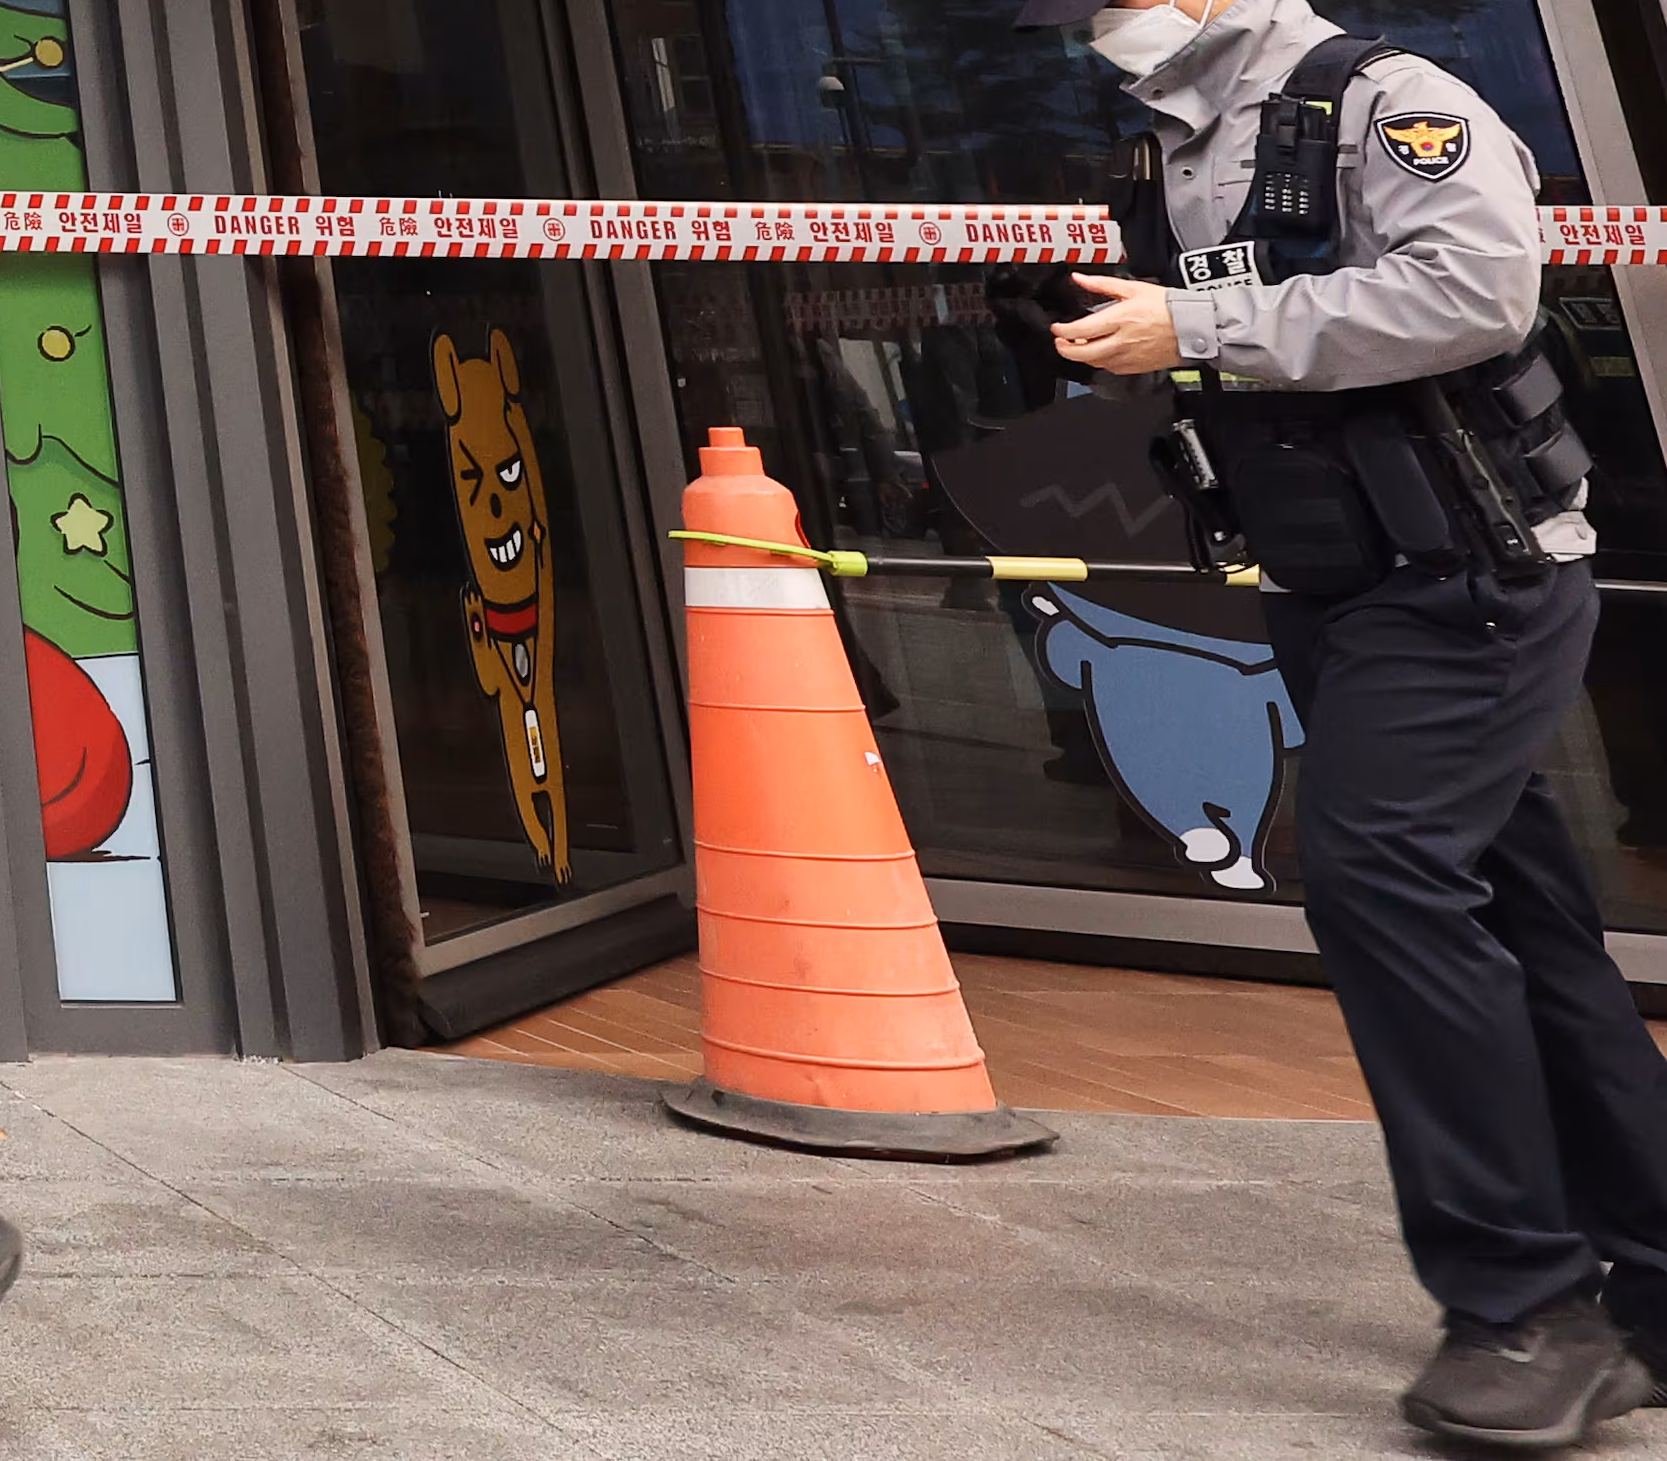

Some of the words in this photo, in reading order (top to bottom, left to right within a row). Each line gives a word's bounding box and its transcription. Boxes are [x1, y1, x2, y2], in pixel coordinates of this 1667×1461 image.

[58, 212, 143, 233] 안전제일
[214, 215, 301, 235] DANGER
[315, 216, 356, 237] 위험
[434, 217, 519, 239] 안전제일
[590, 220, 677, 240] DANGER
[690, 220, 732, 242] 위험
[809, 221, 895, 243] 안전제일
[964, 223, 1053, 243] DANGER
[1066, 222, 1108, 244] 위험
[1559, 224, 1646, 245] 안전제일
[1187, 248, 1247, 280] 경찰
